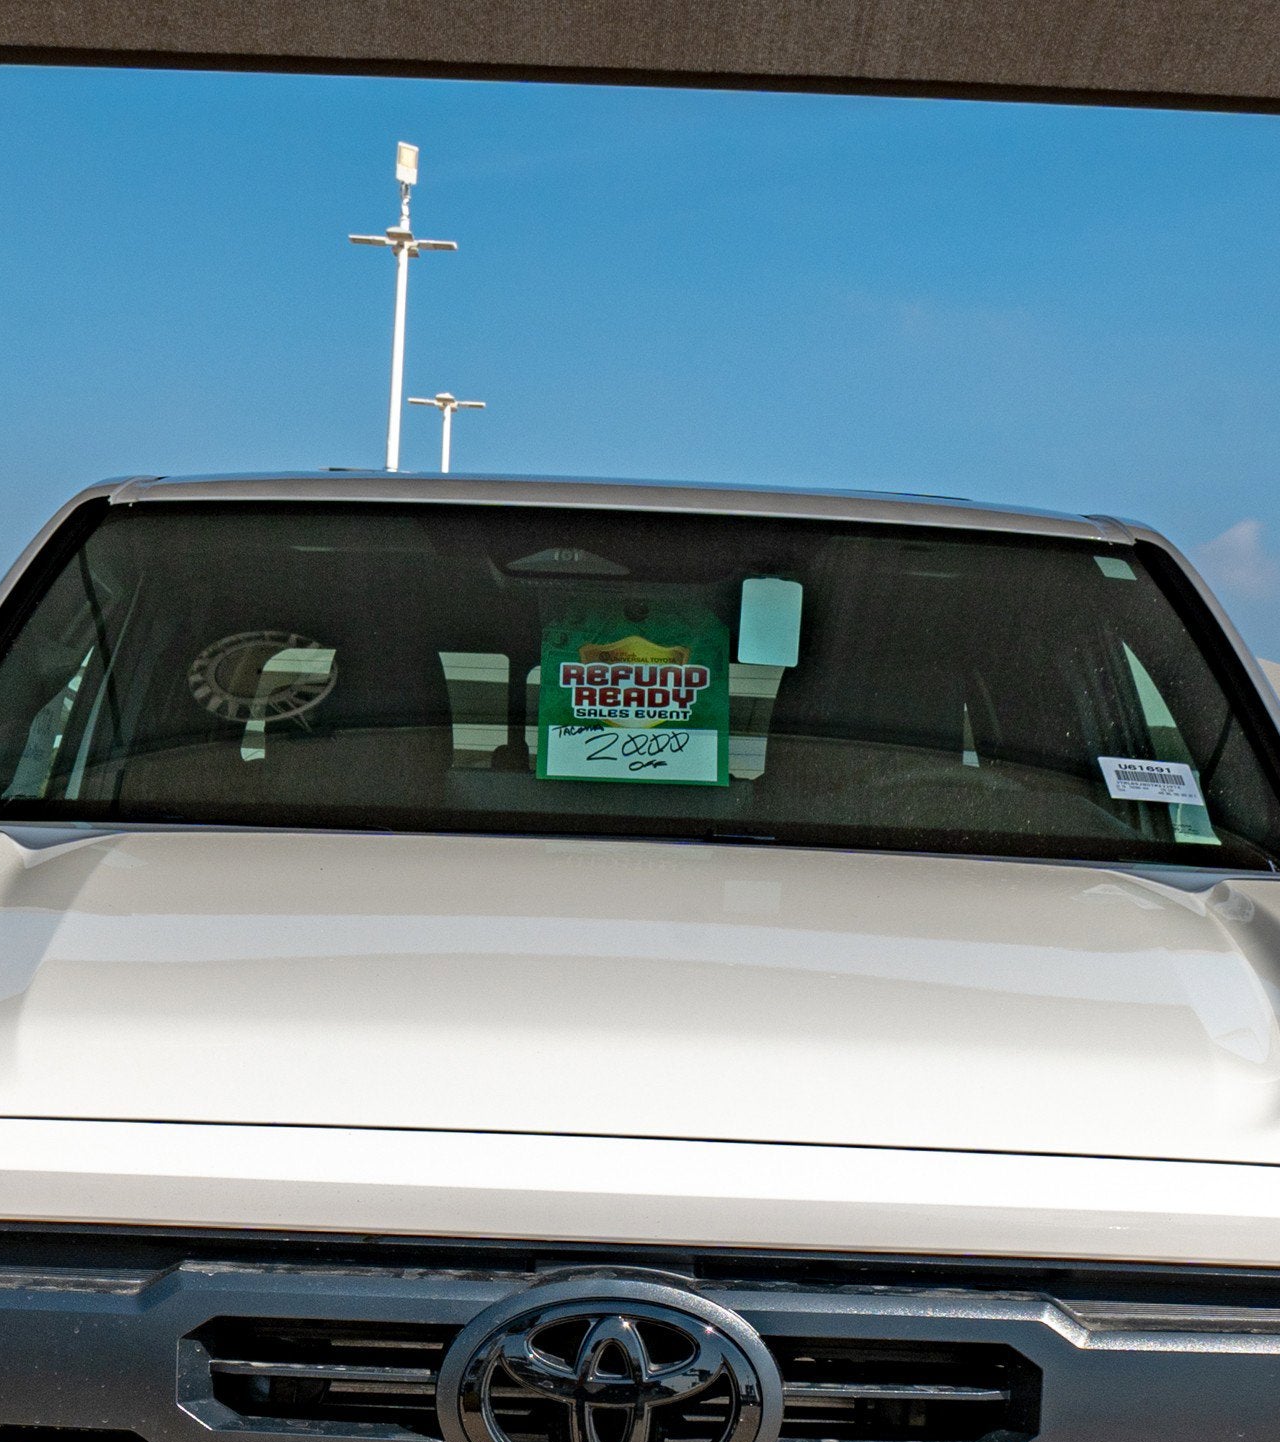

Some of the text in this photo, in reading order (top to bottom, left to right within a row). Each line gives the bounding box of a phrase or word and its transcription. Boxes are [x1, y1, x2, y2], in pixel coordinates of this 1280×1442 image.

[562, 663, 708, 688] REFUND
[574, 687, 695, 709] READY
[575, 708, 691, 720] SALES EVENT
[1118, 763, 1172, 774] U61691
